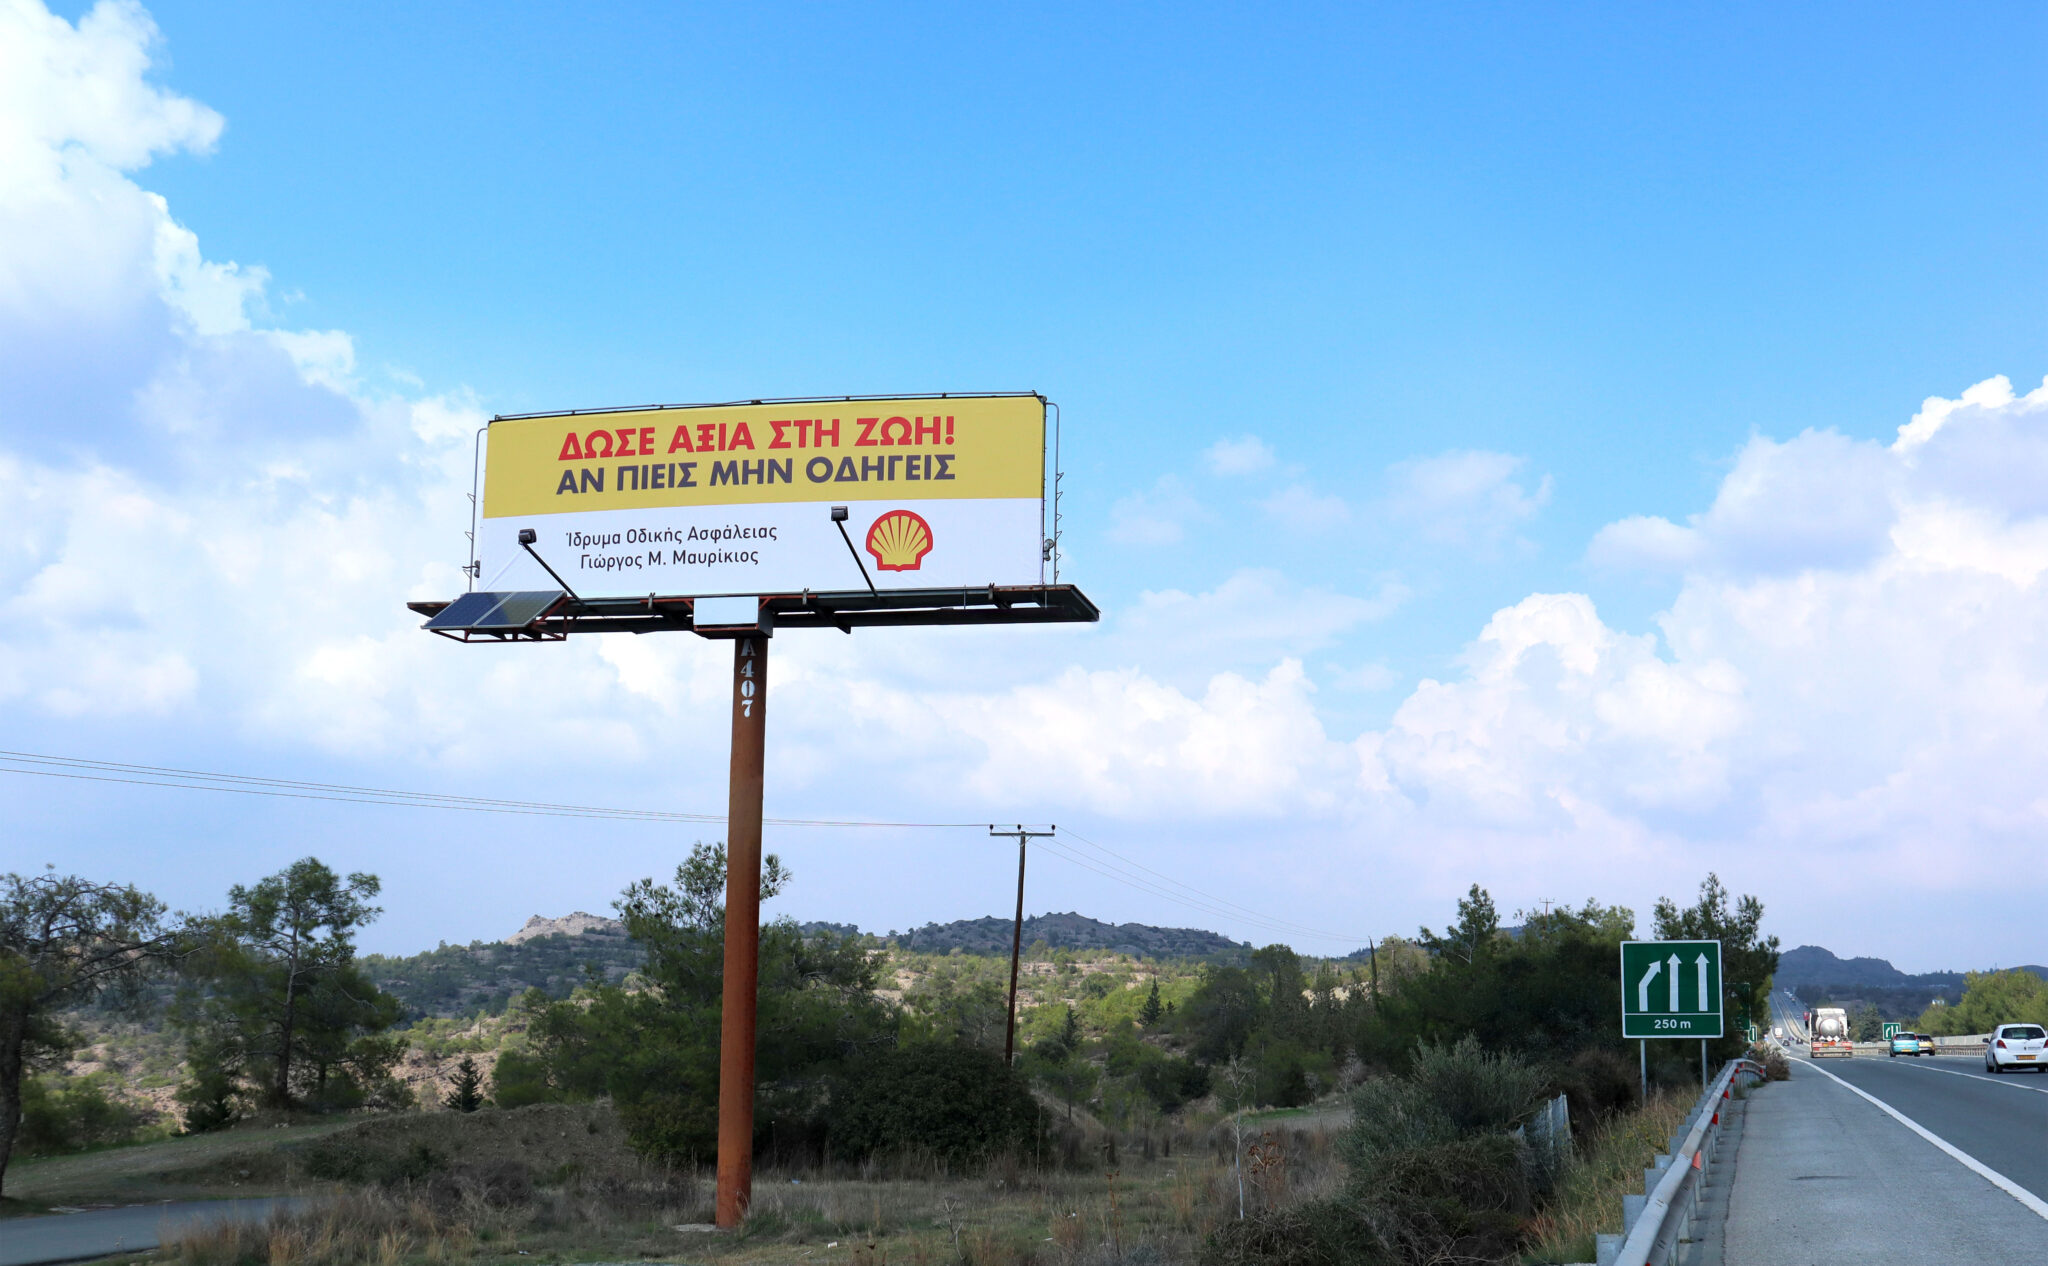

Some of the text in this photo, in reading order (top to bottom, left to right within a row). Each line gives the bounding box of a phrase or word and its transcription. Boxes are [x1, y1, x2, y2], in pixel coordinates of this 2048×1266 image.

[558, 416, 955, 461] ΔΩΣΕ ΑΞΙΑ ΣΤΗ ΖΩΗ!
[556, 454, 956, 495] ΑΝ ΠΙΕΙΣ ΜΗΝ ΟΔΗΓΕΙΣ
[566, 524, 777, 550] Ίδρυμα Οδικής Ασφάλειας
[580, 548, 759, 572] Γιώργος Μ. Μαυρίκιος
[1654, 1019, 1691, 1029] 250 m
